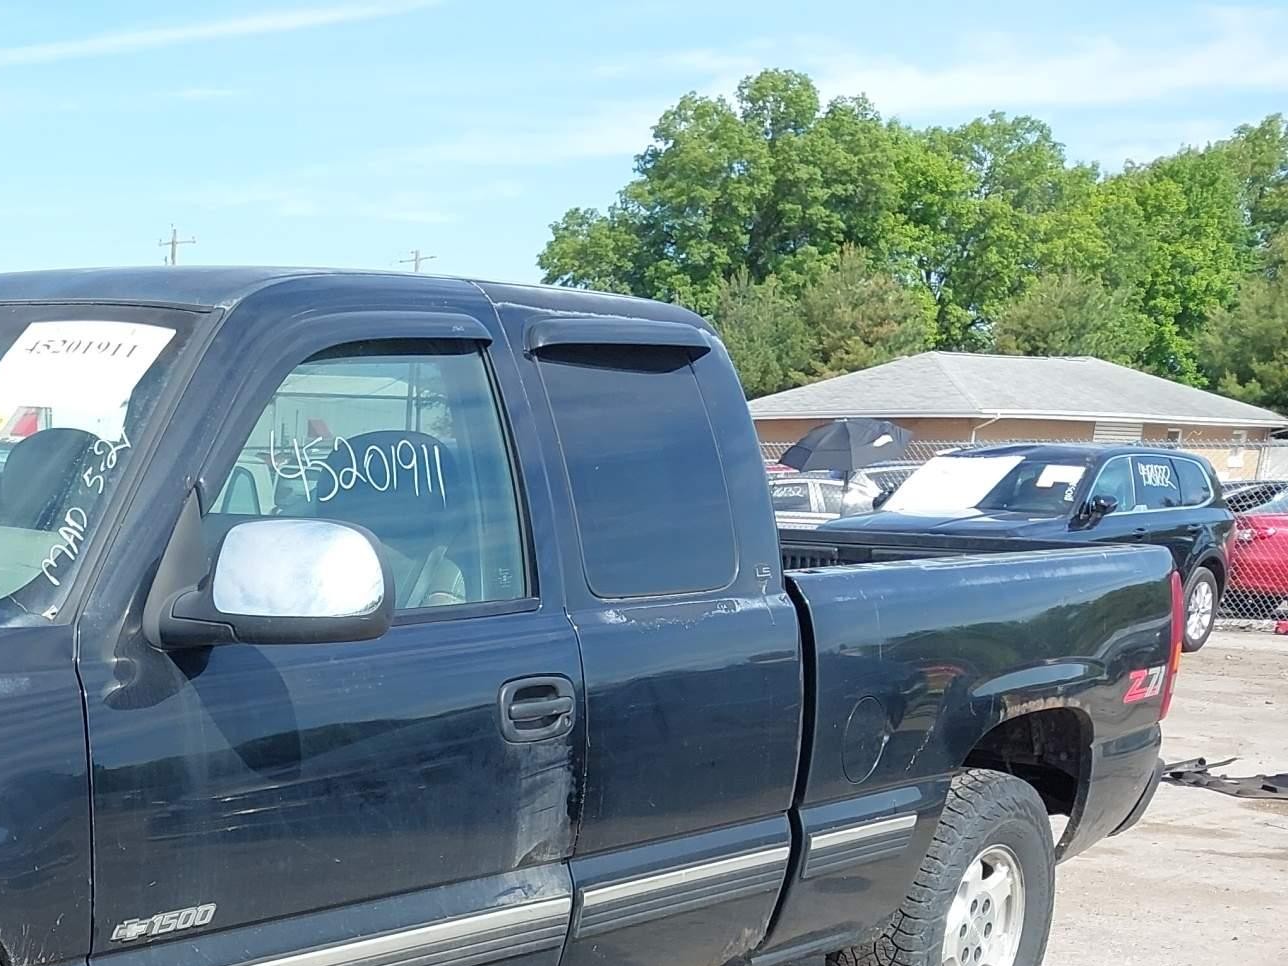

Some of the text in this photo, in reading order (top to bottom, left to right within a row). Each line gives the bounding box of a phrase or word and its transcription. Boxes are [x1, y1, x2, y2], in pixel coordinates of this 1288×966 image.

[24, 339, 140, 359] 45201911
[270, 429, 448, 510] 45201911
[41, 507, 88, 587] MAD
[755, 566, 772, 578] LS
[1122, 664, 1166, 704] Z71
[148, 902, 217, 936] 1500
